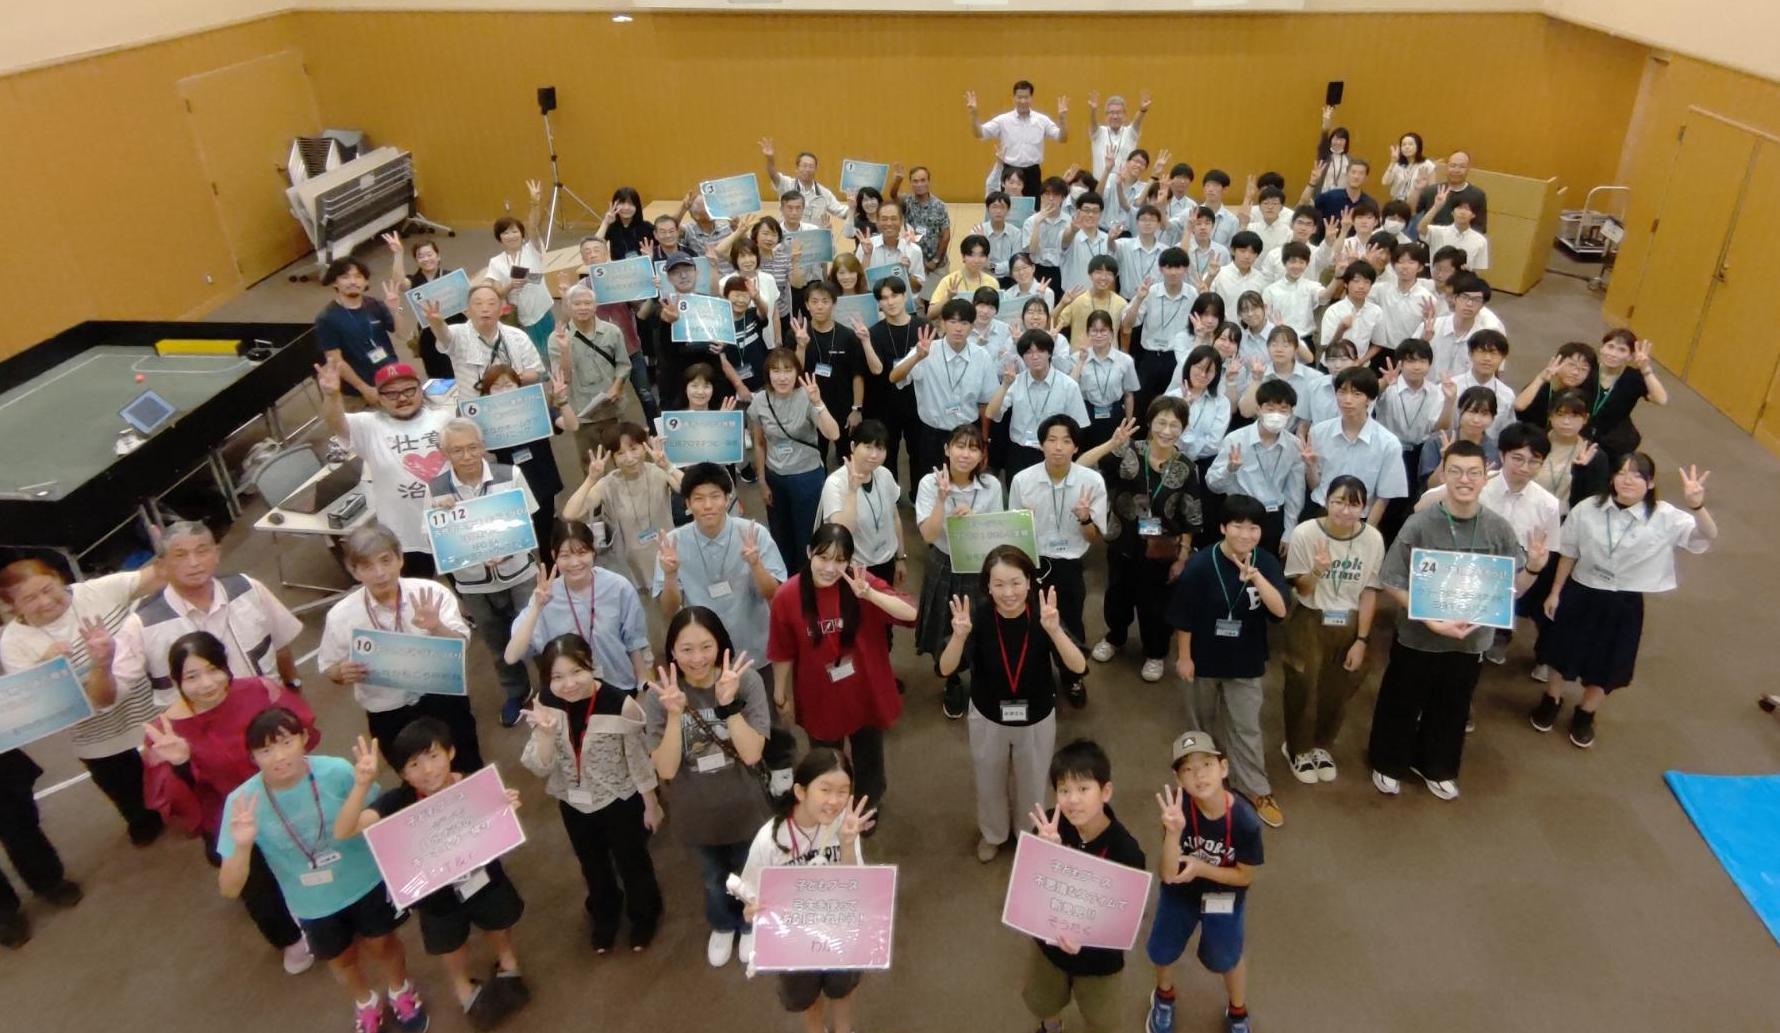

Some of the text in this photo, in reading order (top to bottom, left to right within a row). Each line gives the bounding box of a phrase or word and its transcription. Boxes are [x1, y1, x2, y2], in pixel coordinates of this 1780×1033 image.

[414, 292, 422, 300] 2
[680, 301, 687, 311] 8
[468, 405, 477, 415] 6
[669, 418, 678, 429] 9
[432, 508, 466, 525] 11 12
[1329, 557, 1363, 570] ook
[1421, 561, 1436, 573] 24
[356, 639, 372, 652] 10
[1051, 858, 1112, 889] 子どもブース
[795, 878, 858, 891] 子どもブース
